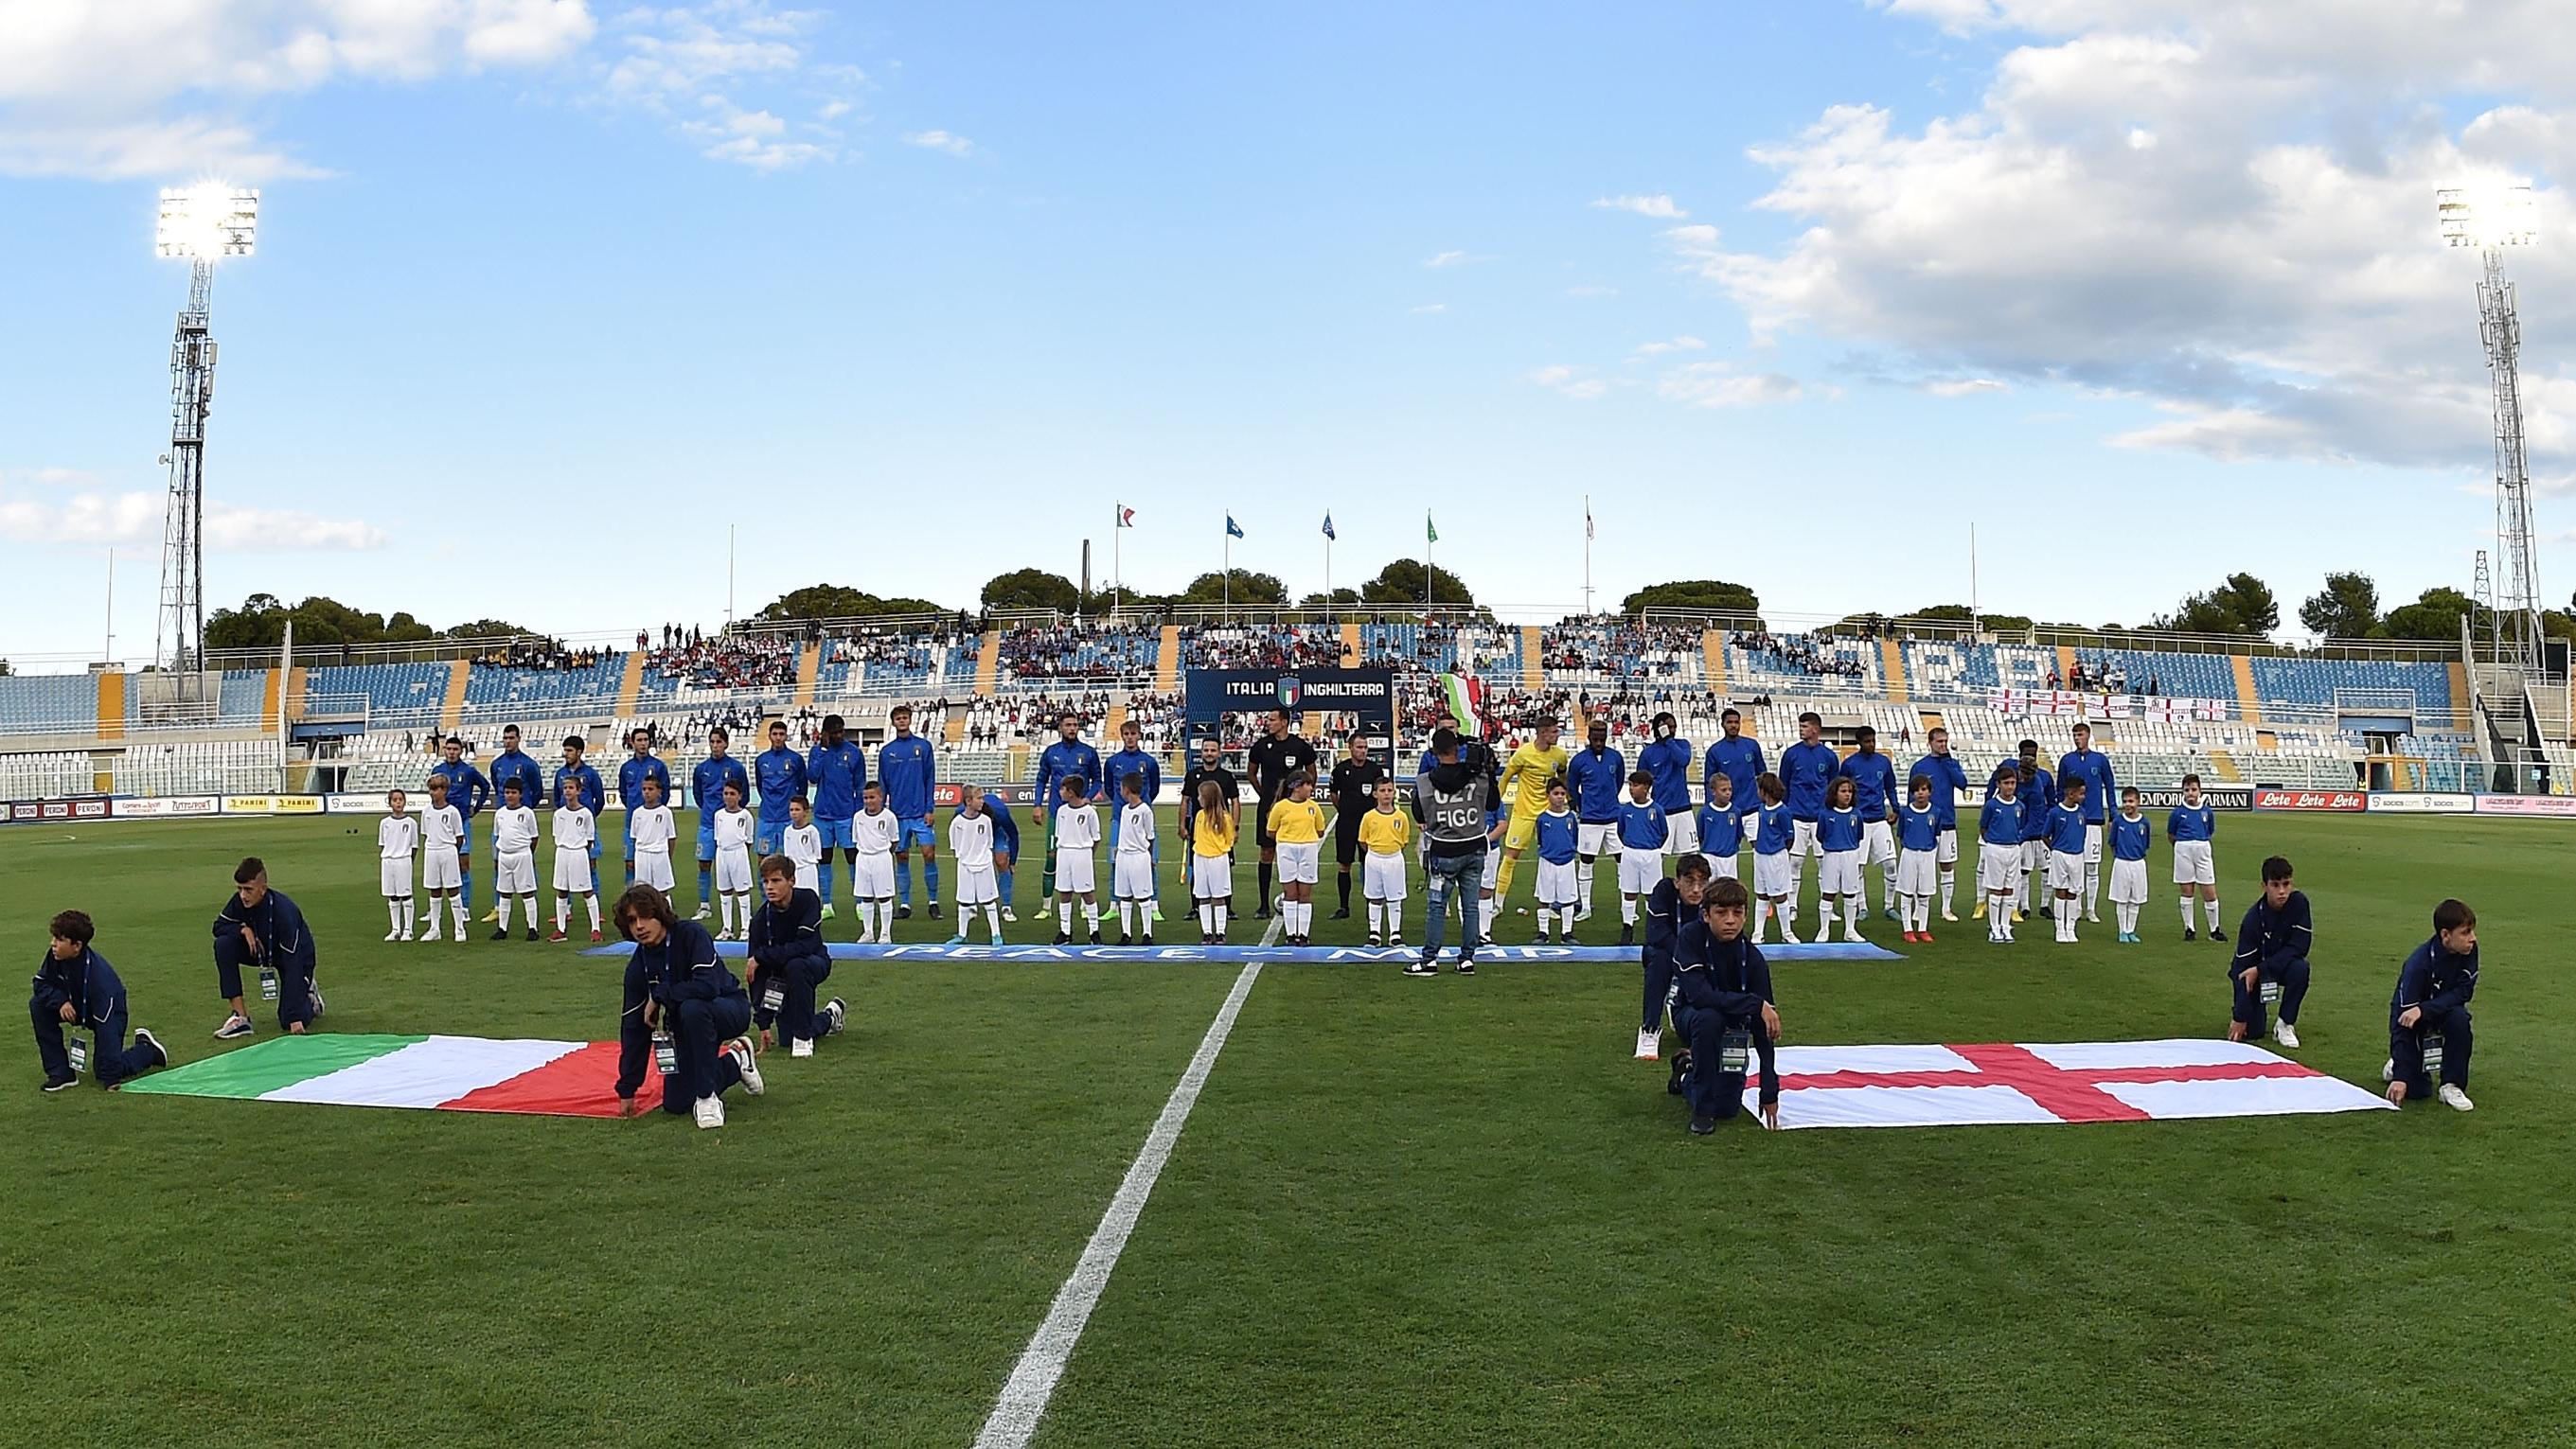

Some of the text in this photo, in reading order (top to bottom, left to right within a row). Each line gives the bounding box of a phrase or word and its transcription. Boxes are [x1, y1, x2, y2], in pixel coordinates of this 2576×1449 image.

[1226, 682, 1384, 697] ITALIA INGHILTERRA
[933, 787, 954, 801] ete
[2140, 792, 2247, 806] EMPORI ARMANI
[2260, 792, 2359, 807] Lete Lete Lete
[16, 804, 104, 816] PERONI PERONI PERONI
[1436, 807, 1478, 827] FIGC
[881, 945, 1206, 959] PEACE
